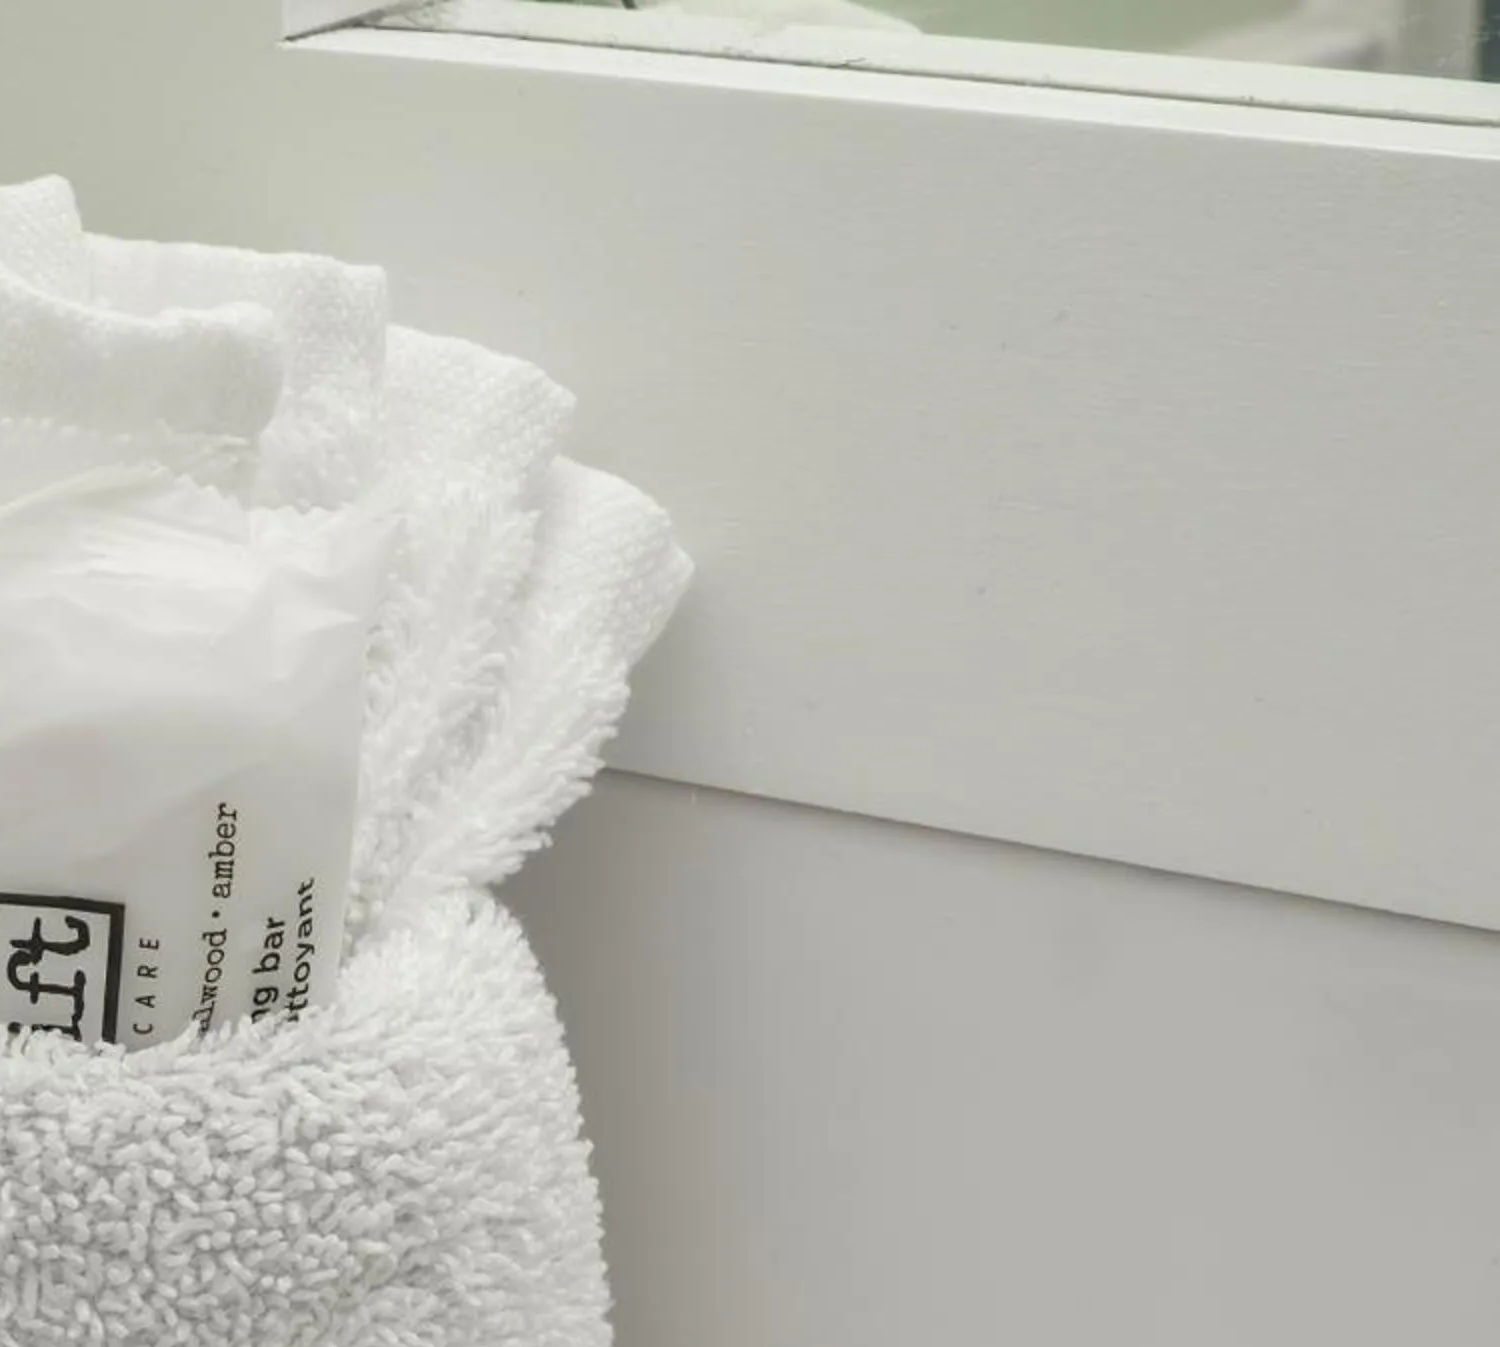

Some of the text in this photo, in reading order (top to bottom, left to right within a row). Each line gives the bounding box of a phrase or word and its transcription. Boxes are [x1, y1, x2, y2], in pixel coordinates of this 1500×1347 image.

[208, 802, 238, 899] amber
[132, 937, 160, 1036] CARE
[258, 916, 287, 972] bar
